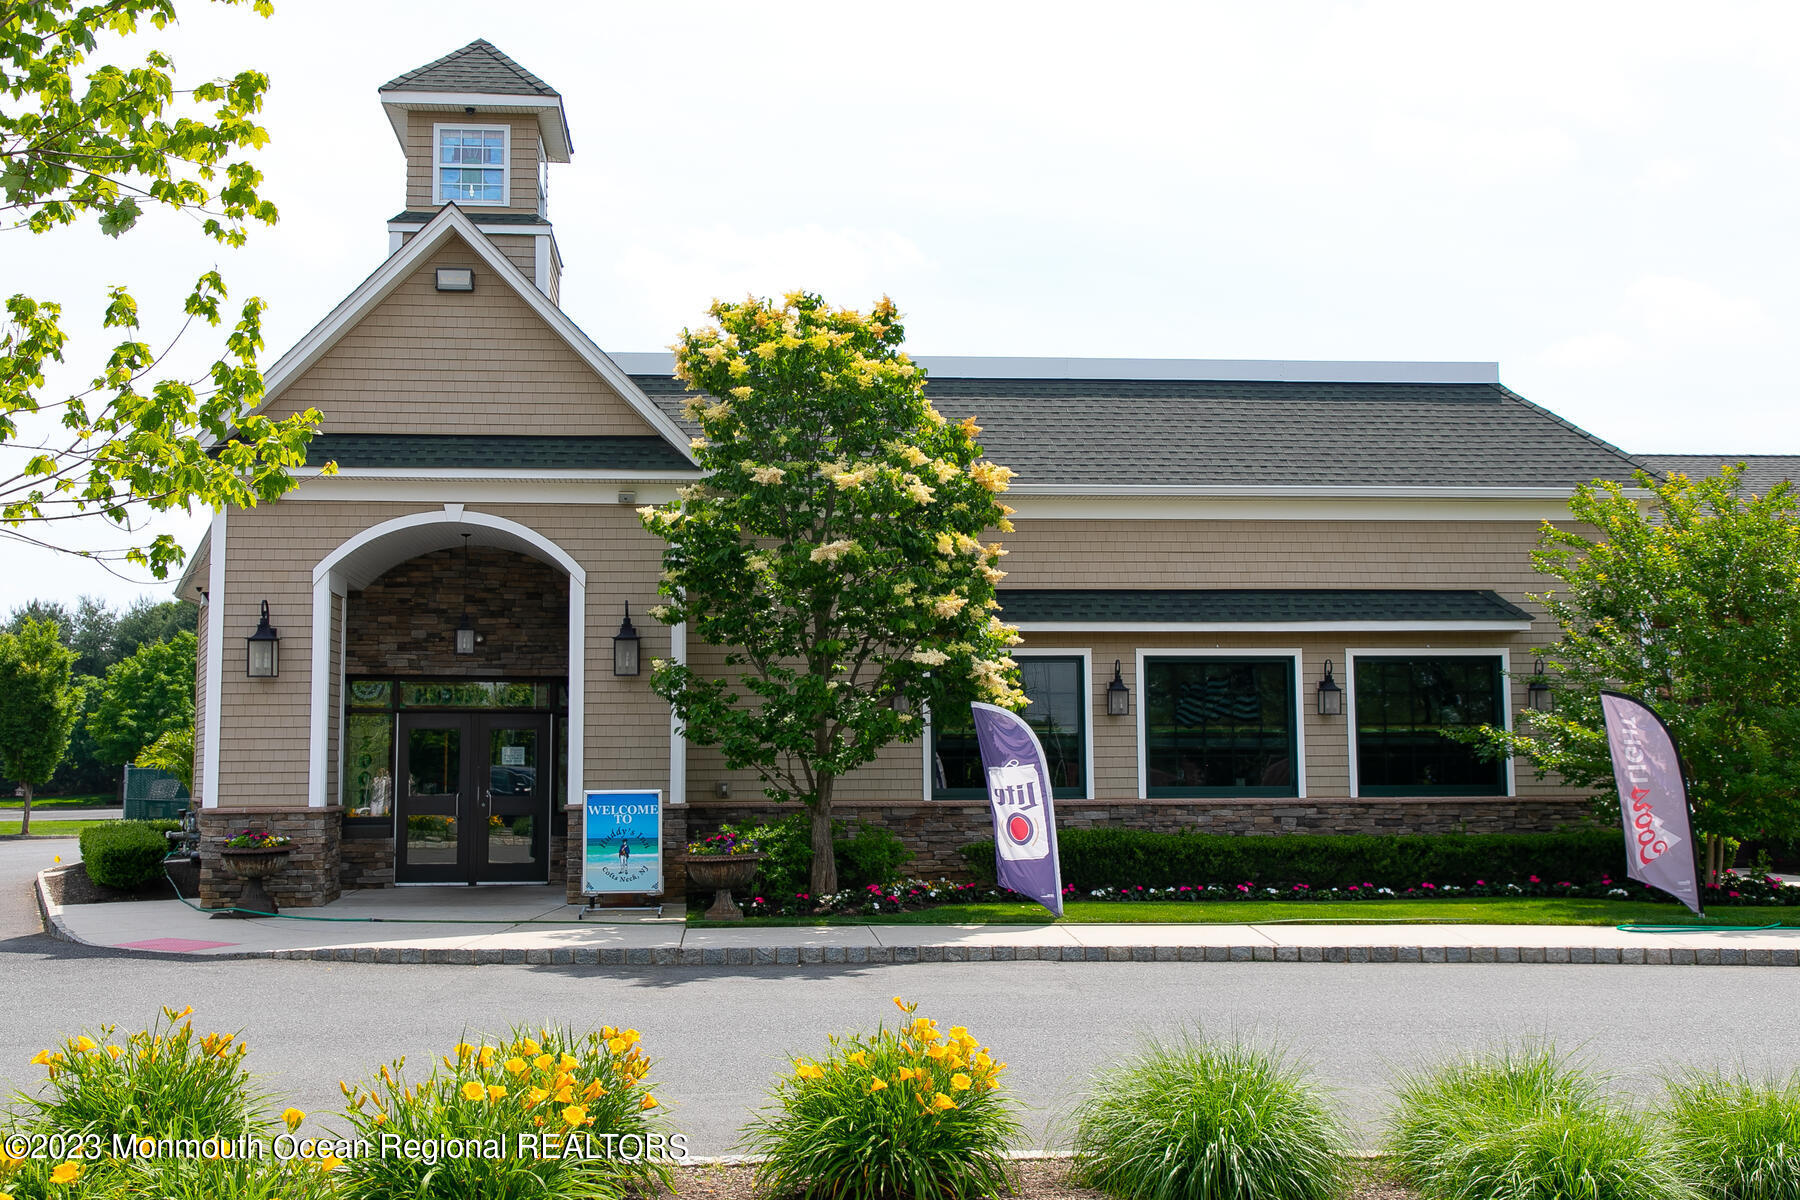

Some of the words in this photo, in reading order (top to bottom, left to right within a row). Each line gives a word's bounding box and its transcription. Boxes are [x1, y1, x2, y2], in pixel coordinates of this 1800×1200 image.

[588, 805, 658, 815] WELCOME
[614, 814, 632, 824] TO
[636, 832, 651, 849] Inn
[602, 867, 618, 881] Colts
[639, 864, 649, 875] NJ
